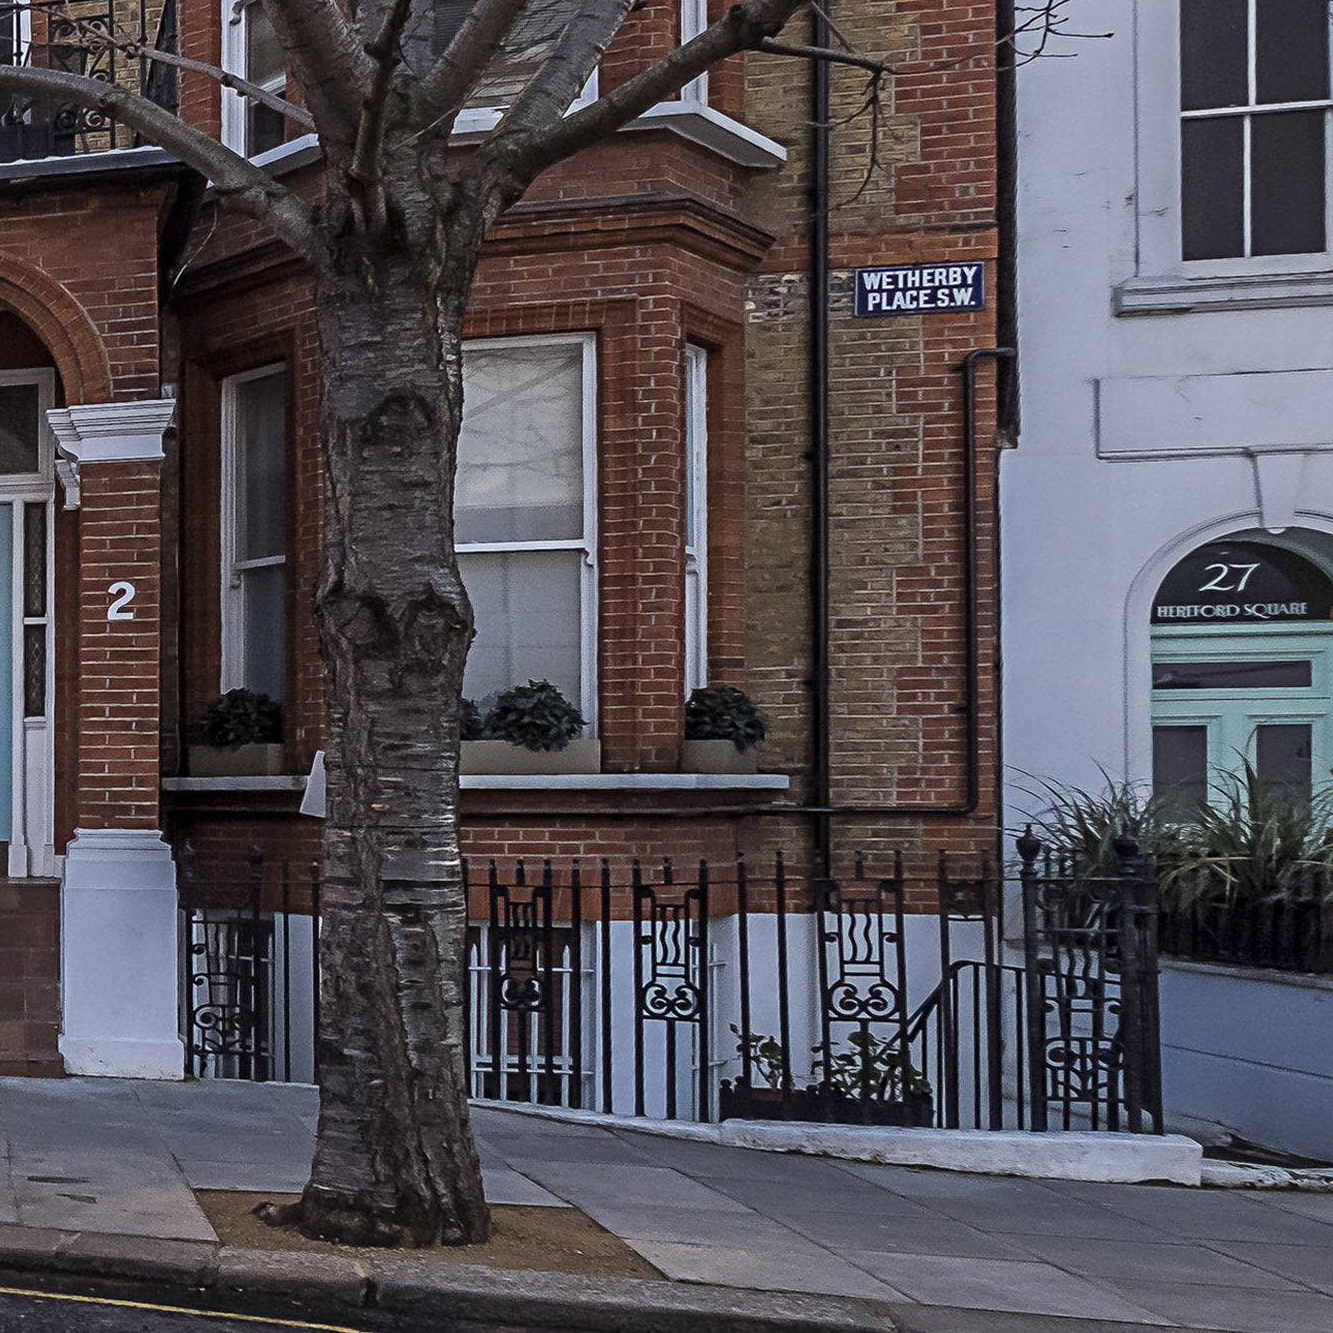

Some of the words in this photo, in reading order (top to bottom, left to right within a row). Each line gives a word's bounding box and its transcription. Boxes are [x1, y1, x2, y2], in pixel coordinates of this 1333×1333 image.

[862, 266, 978, 291] WETHERBY
[867, 291, 936, 312] PLACE
[936, 287, 976, 308] S.W.
[1198, 562, 1262, 593] 27
[106, 580, 136, 621] 2
[1156, 604, 1241, 618] HERTFORD
[1243, 601, 1308, 619] SQUARE
